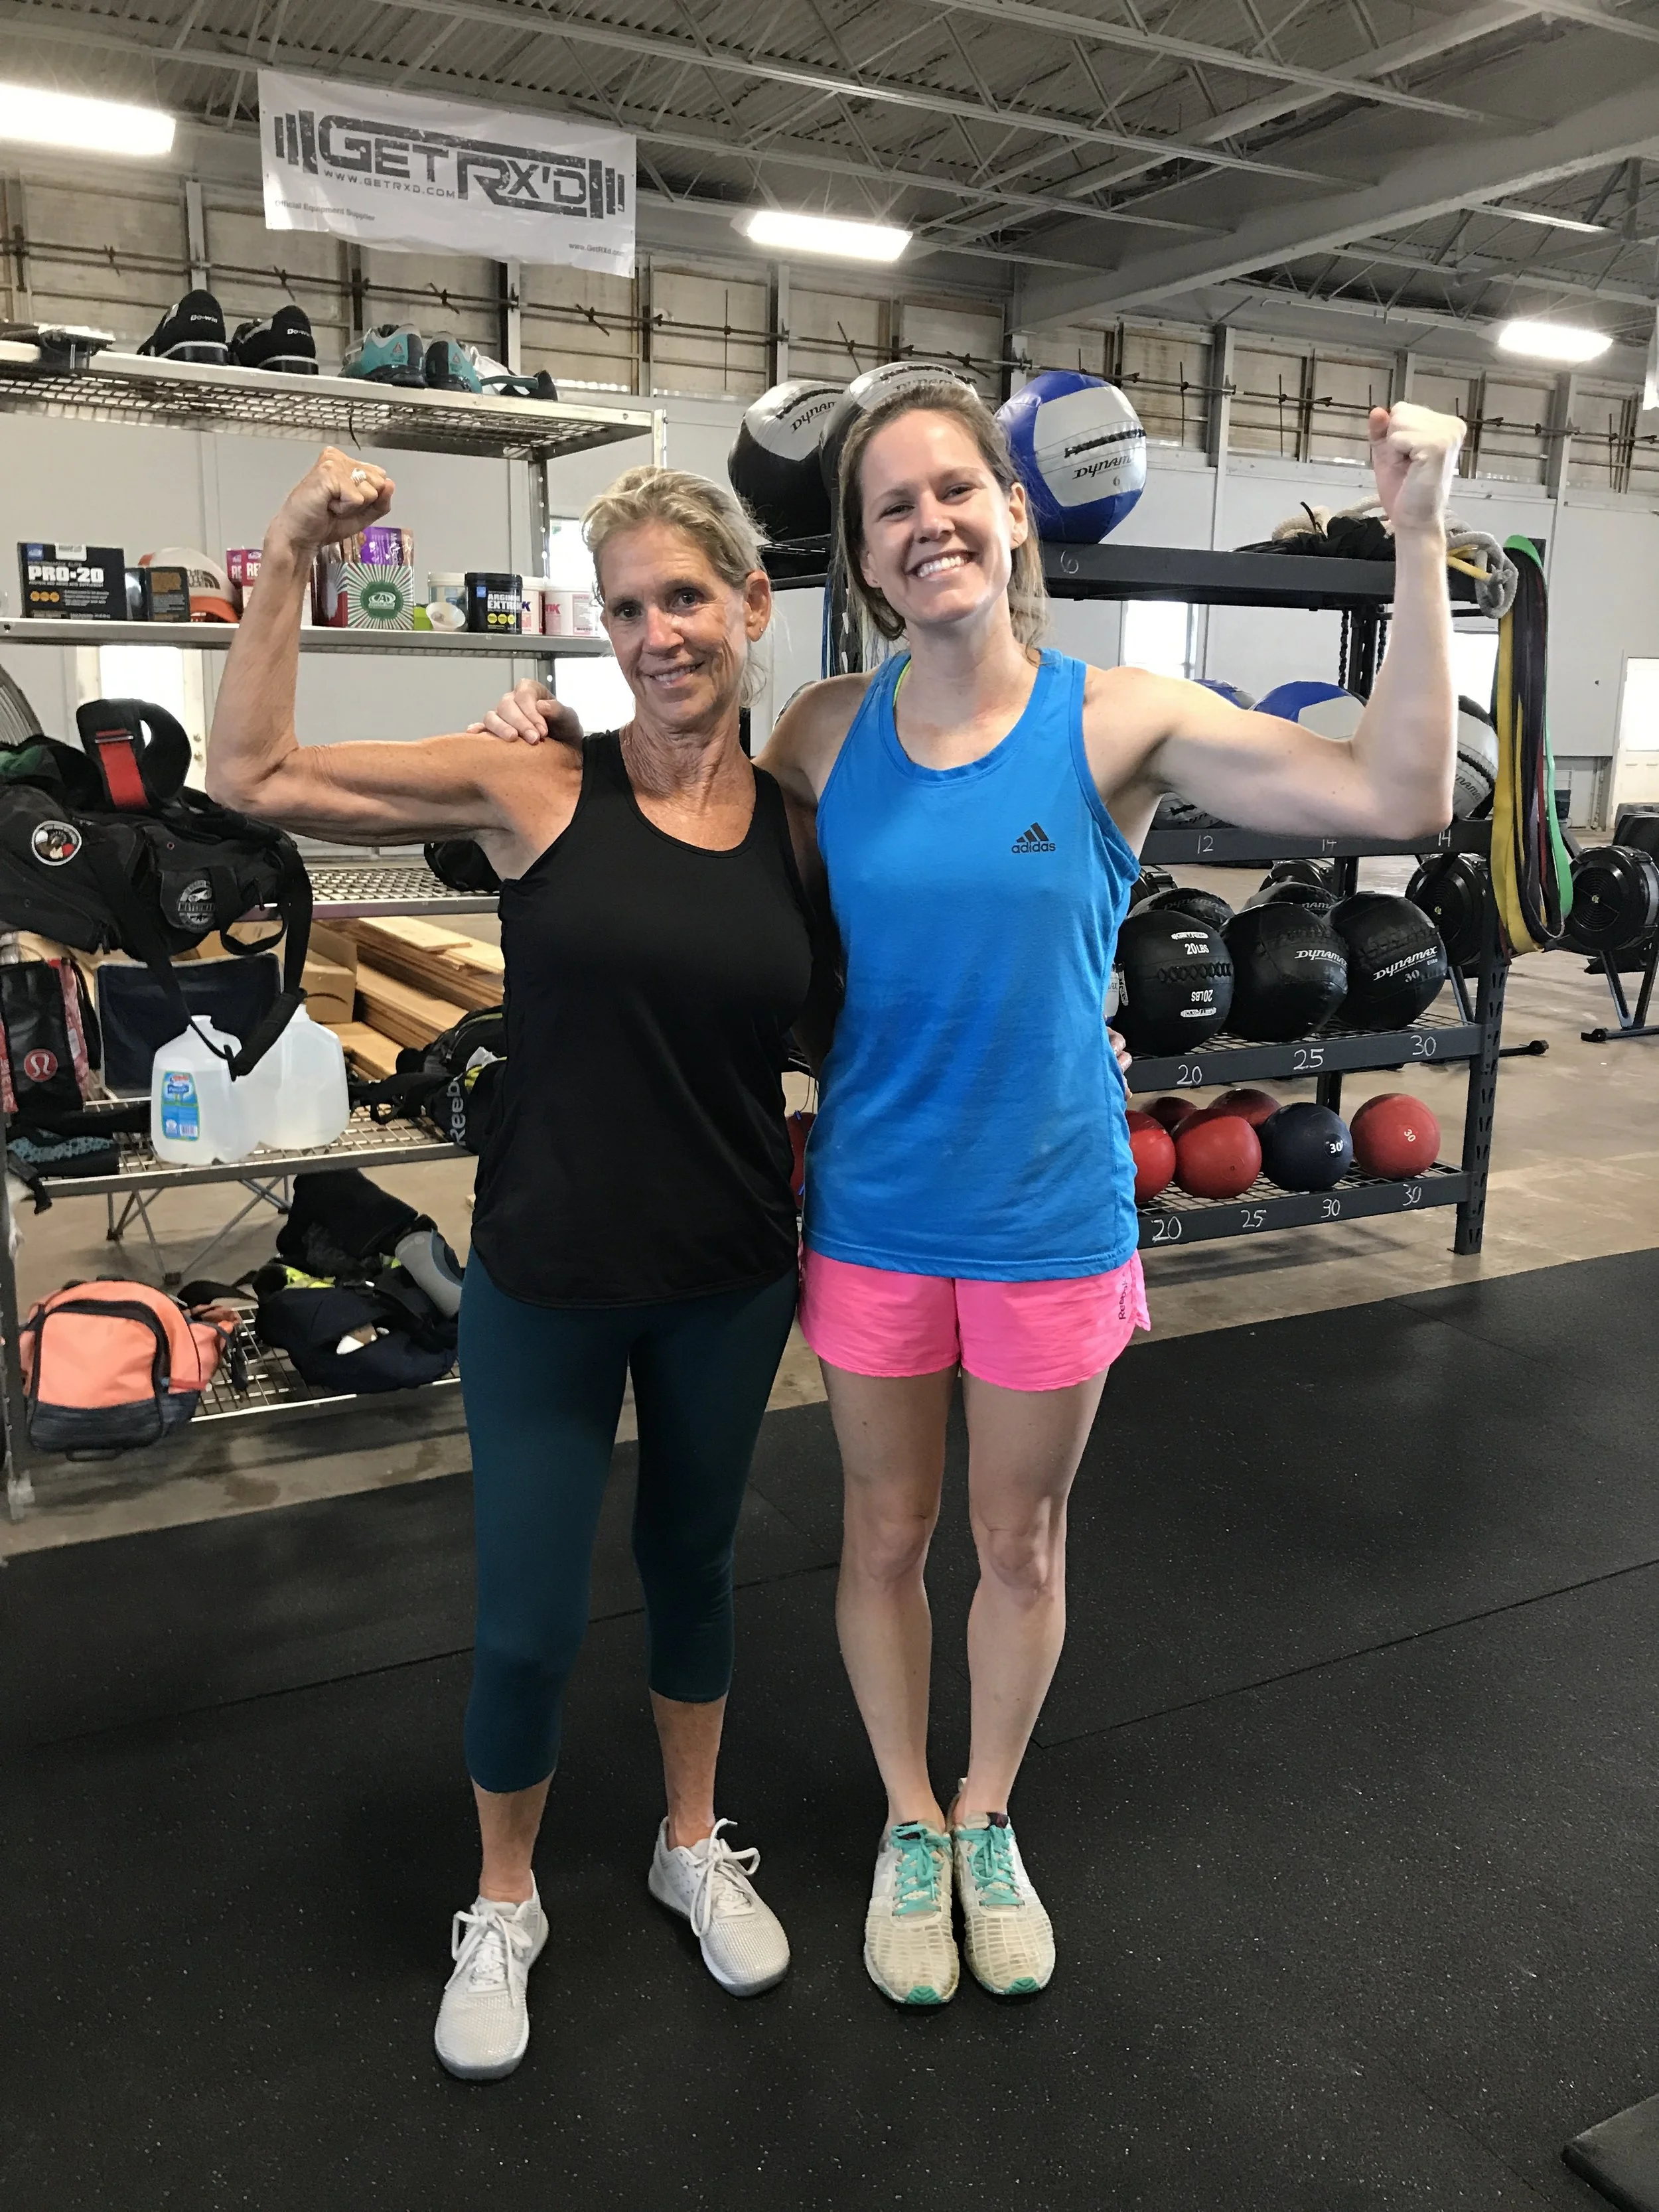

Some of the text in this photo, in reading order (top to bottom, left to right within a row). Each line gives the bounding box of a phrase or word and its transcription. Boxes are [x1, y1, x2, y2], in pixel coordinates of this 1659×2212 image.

[324, 169, 455, 198] WWW.GETRXD.COM
[1112, 475, 1121, 486] 6
[28, 565, 104, 583] PRO-20
[1011, 842, 1056, 853] adidas
[1197, 835, 1214, 854] 12
[1437, 830, 1451, 848] 14
[1373, 946, 1438, 981] DYNAMAX
[1405, 970, 1420, 983] 30
[1410, 1035, 1437, 1057] 30
[1293, 1048, 1325, 1070] 25
[1177, 1065, 1202, 1085] 20
[1404, 1128, 1416, 1142] 30
[1329, 1142, 1342, 1153] 30
[1402, 1183, 1422, 1207] 30
[1321, 1199, 1340, 1218] 30
[1240, 1209, 1267, 1228] 25
[1152, 1216, 1182, 1242] 20
